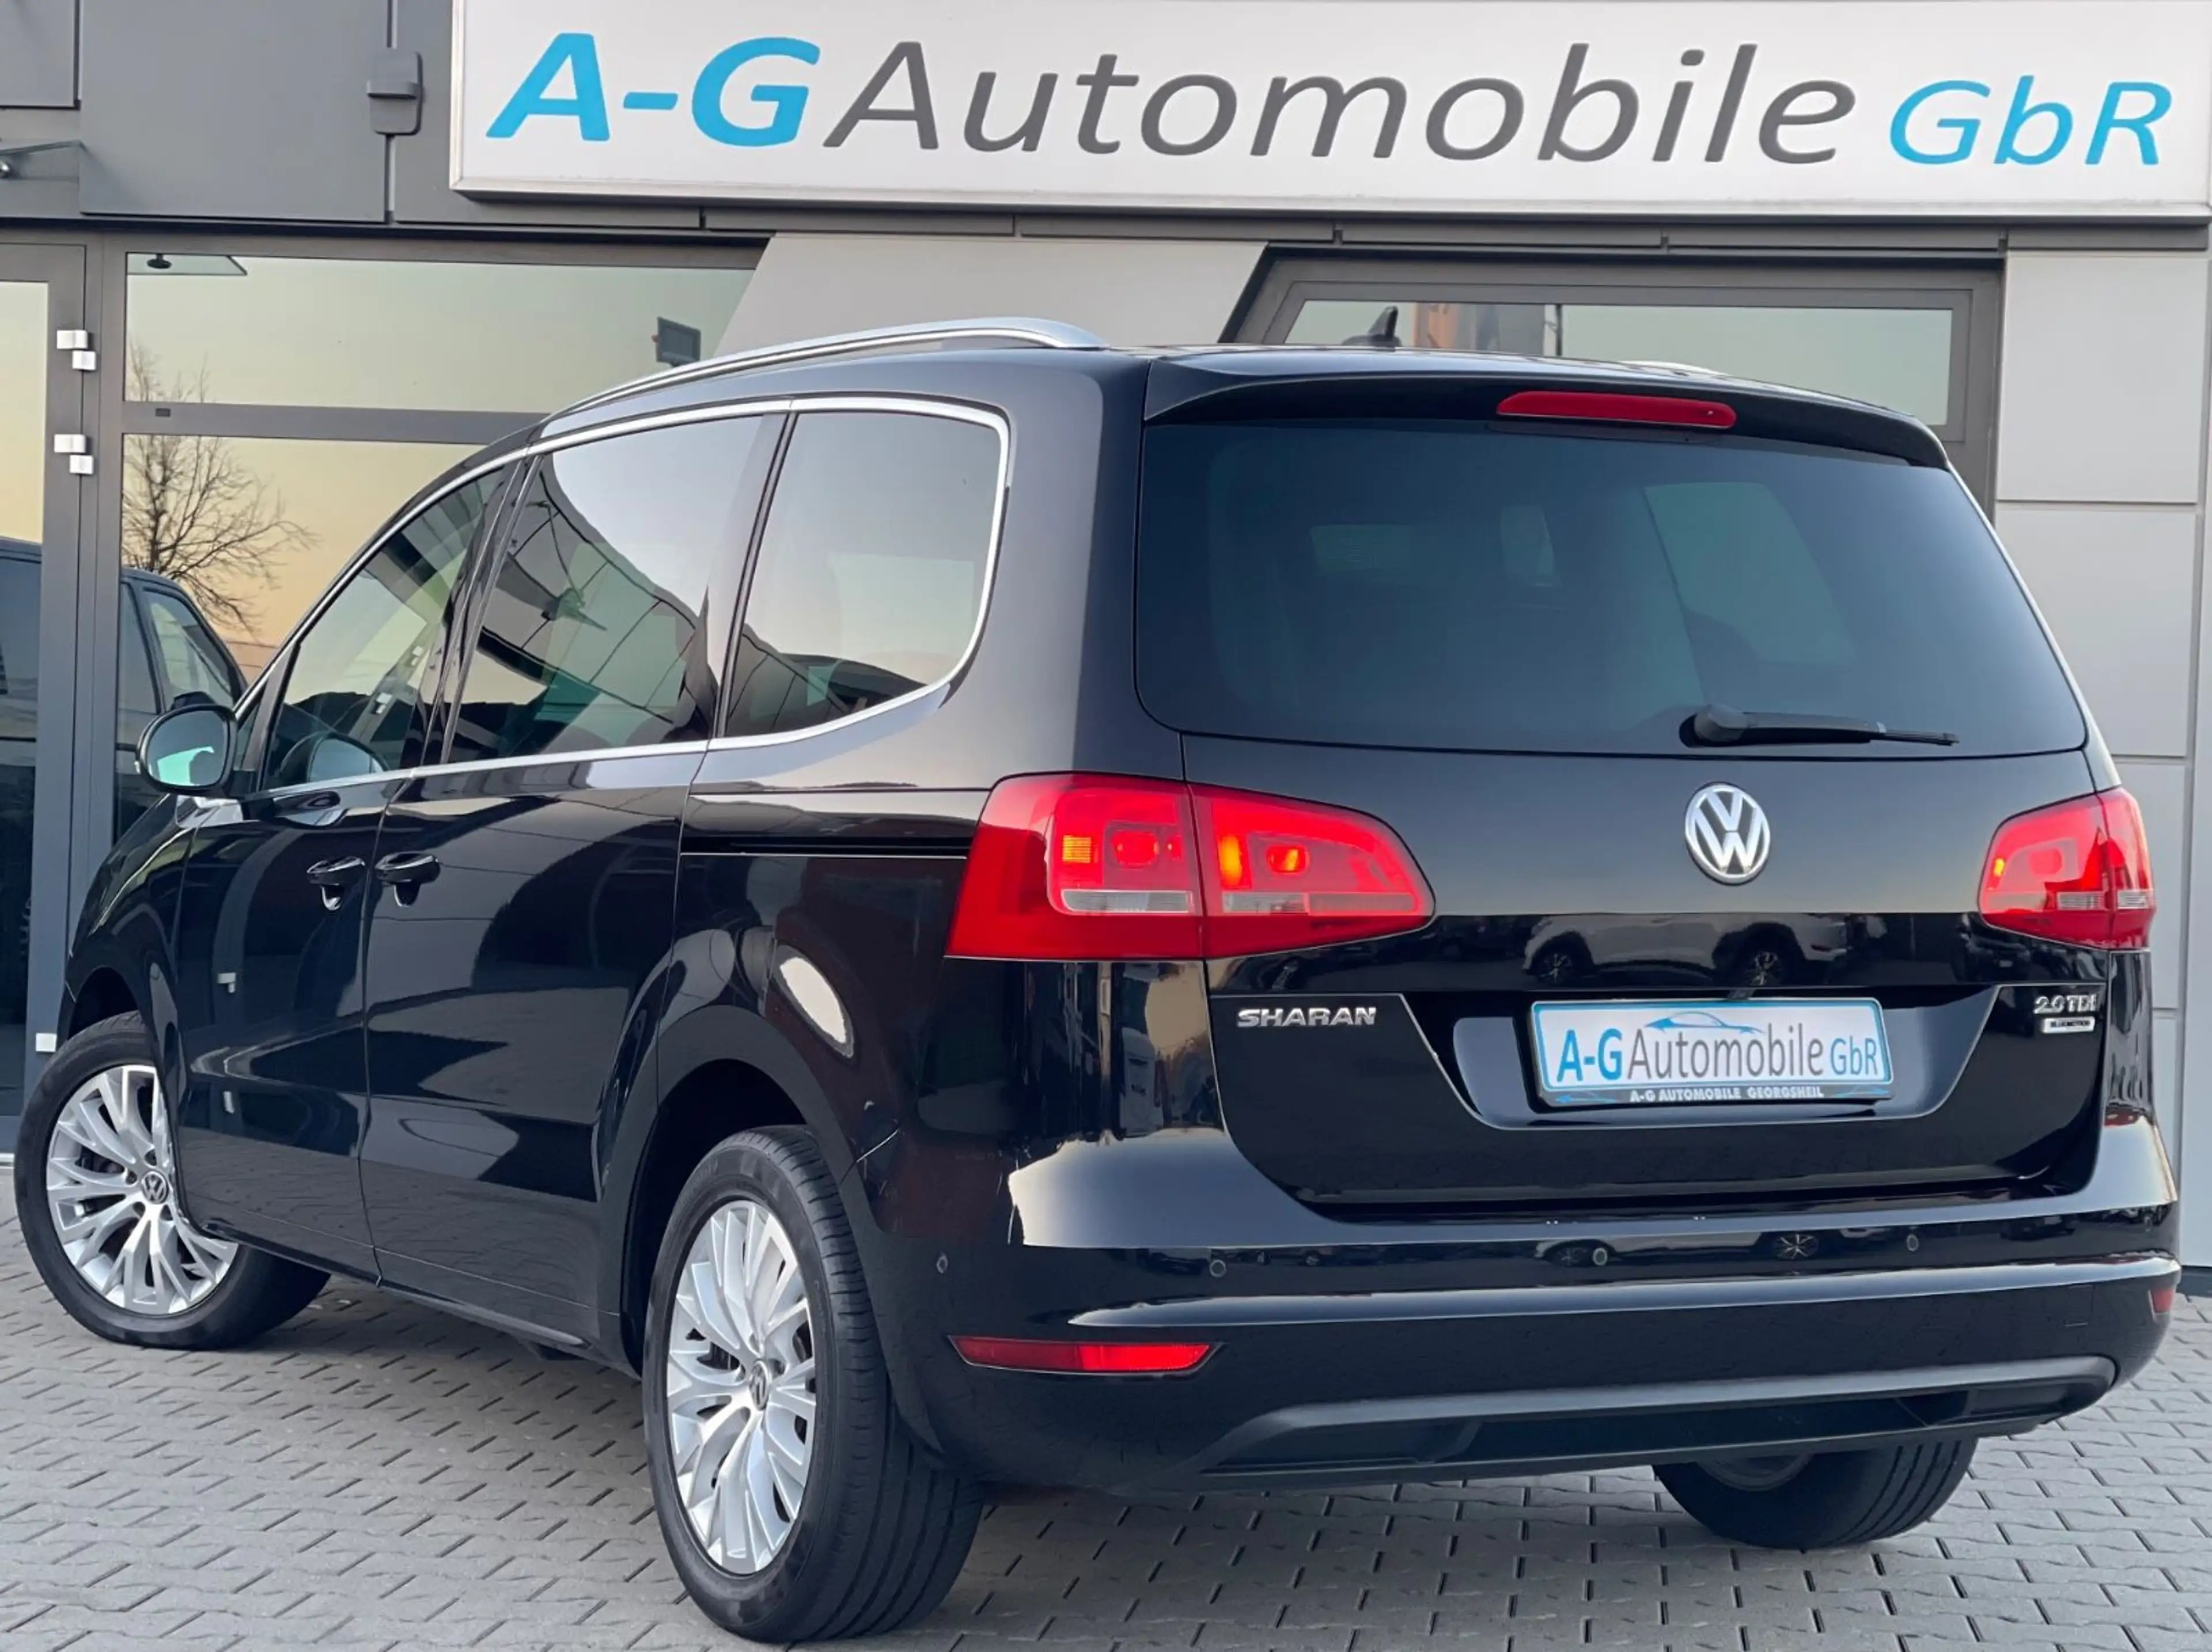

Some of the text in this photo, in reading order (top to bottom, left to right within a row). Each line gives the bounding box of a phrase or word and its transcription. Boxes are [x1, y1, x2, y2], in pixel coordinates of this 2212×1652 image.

[486, 32, 2172, 166] A-G Automobile GbR
[1237, 1006, 1377, 1028] SHARAN
[1556, 1023, 1878, 1082] A-G Automobile GbR
[1658, 1087, 1741, 1102] AUTOMOBILE
[1747, 1085, 1824, 1100] GEORGSHEIL
